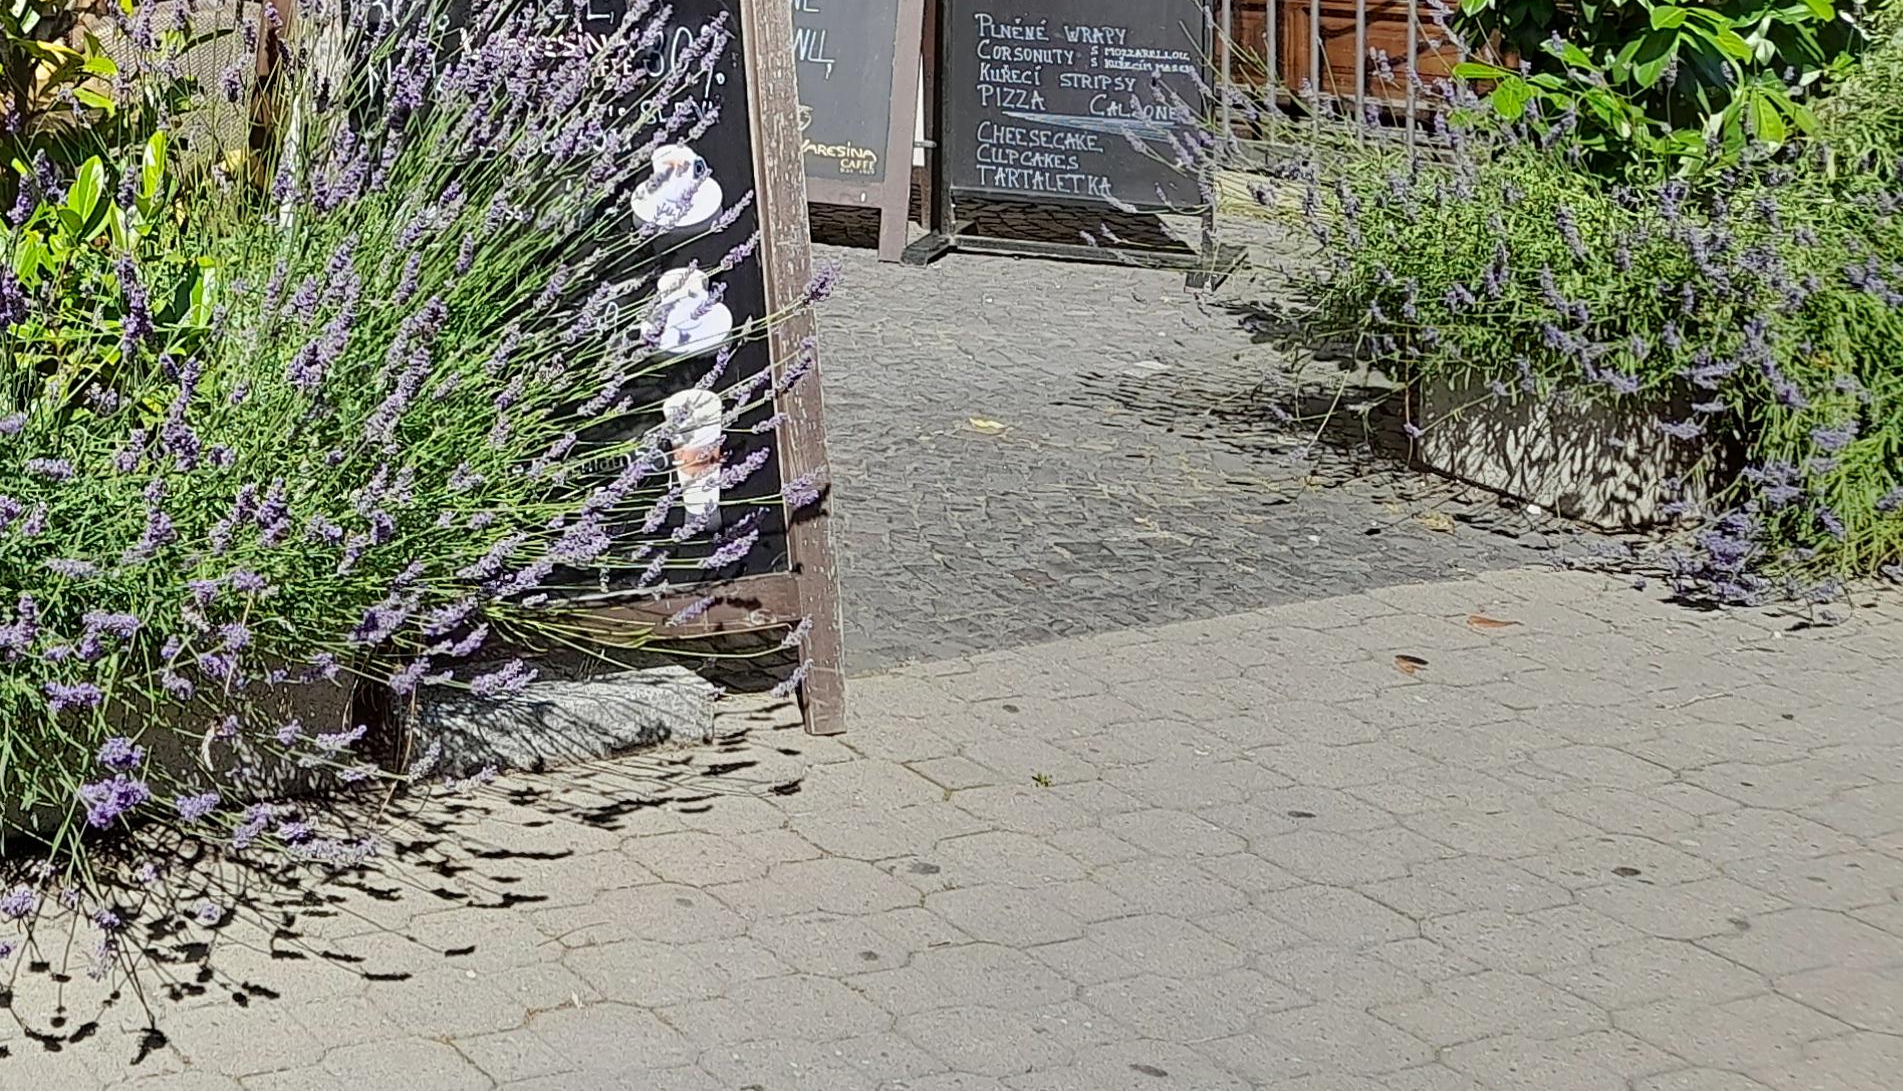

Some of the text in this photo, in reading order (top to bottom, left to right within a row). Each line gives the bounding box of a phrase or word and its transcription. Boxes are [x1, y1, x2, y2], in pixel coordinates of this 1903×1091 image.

[974, 13, 1127, 45] PLNĚNÉ WRAPY
[977, 39, 1075, 65] CORSONUTY
[978, 62, 1137, 93] KUŘECÍ STRIPSY
[977, 84, 1179, 122] PIZZA CALONE
[977, 121, 1104, 153] CHEESECAKE
[976, 143, 1080, 170] CUPCAKES
[976, 164, 1112, 196] TARTALETKA
